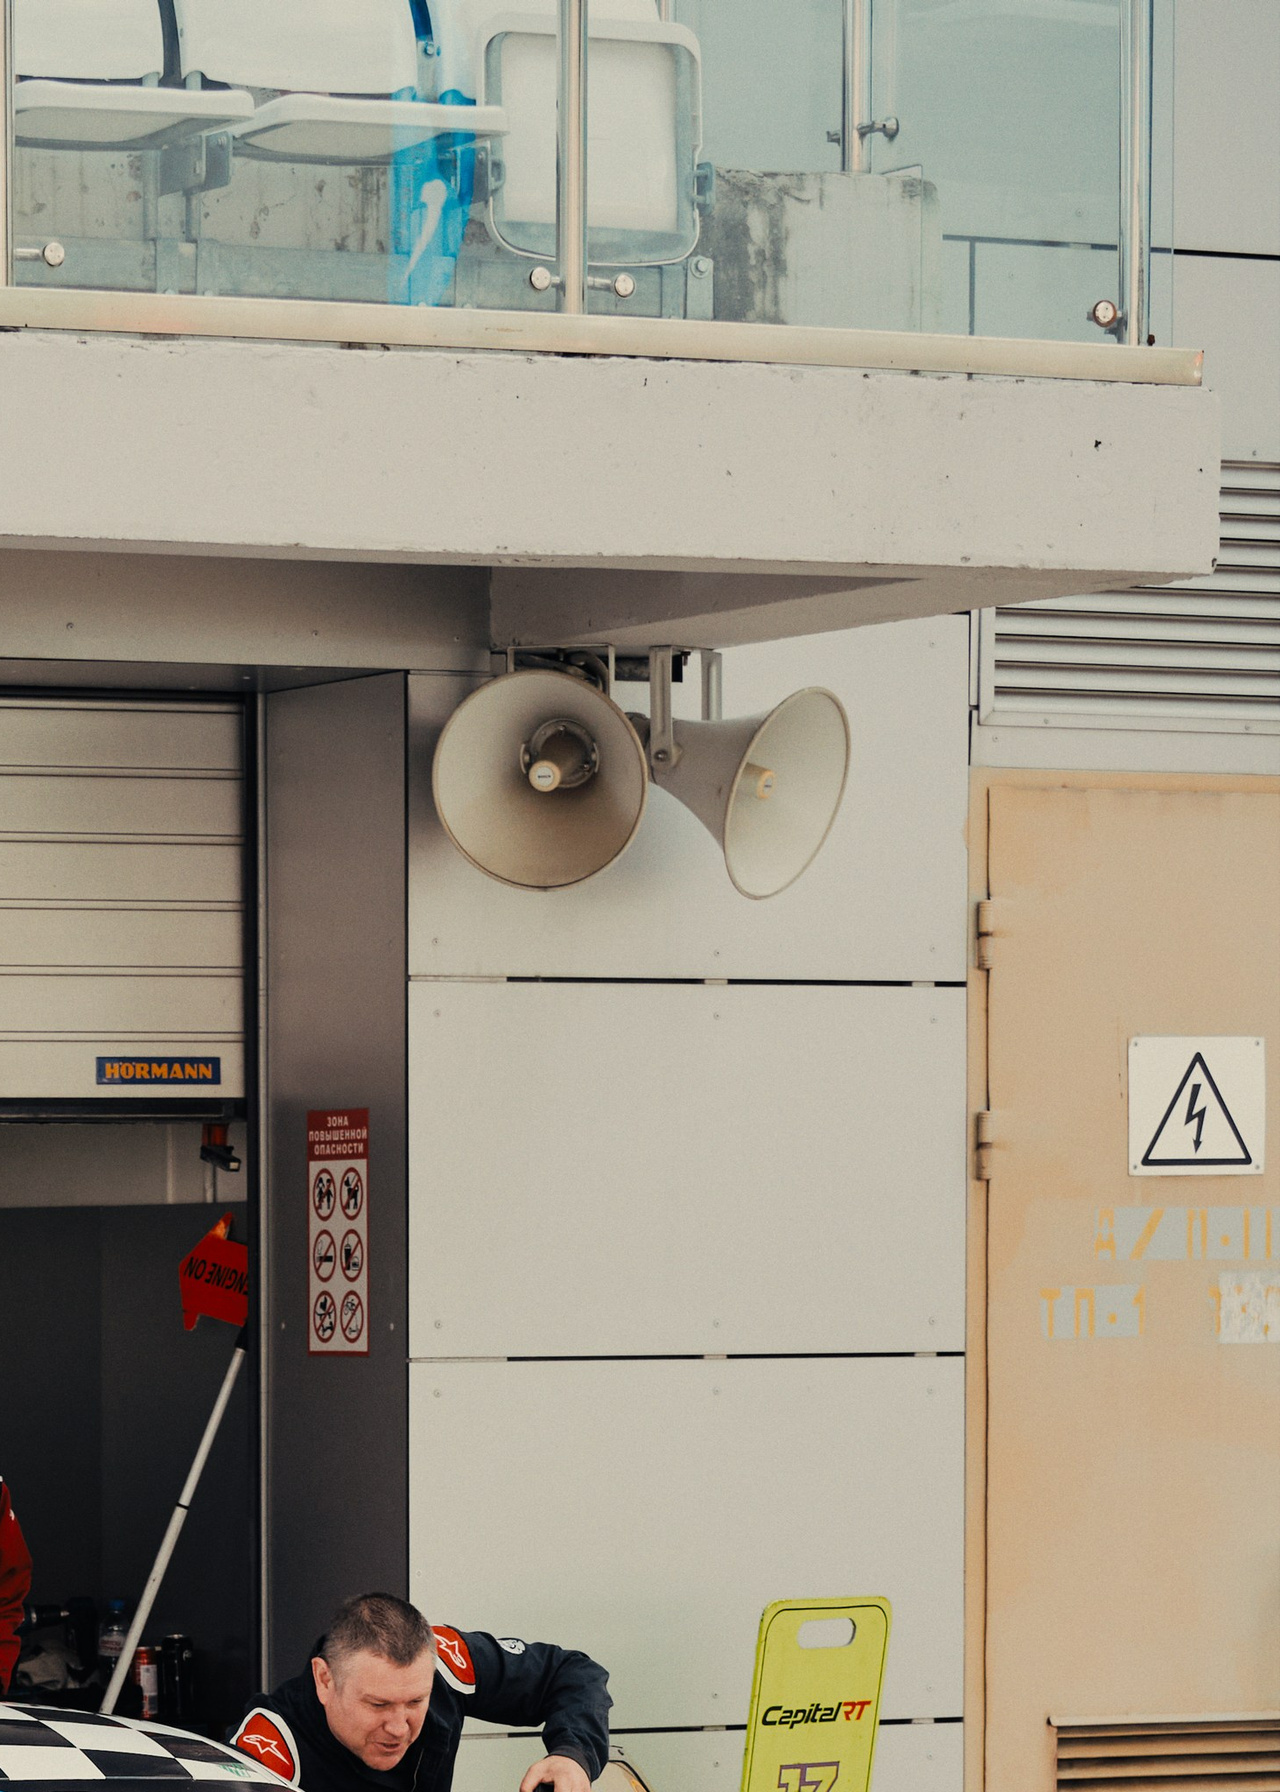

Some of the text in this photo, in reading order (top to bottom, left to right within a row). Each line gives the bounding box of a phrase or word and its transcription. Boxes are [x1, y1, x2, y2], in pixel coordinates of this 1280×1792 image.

[327, 1116, 349, 1127] ЗОНА
[308, 1127, 368, 1141] ПОВЫШЕННОЙ
[314, 1143, 364, 1155] ОПАСНОСТИ
